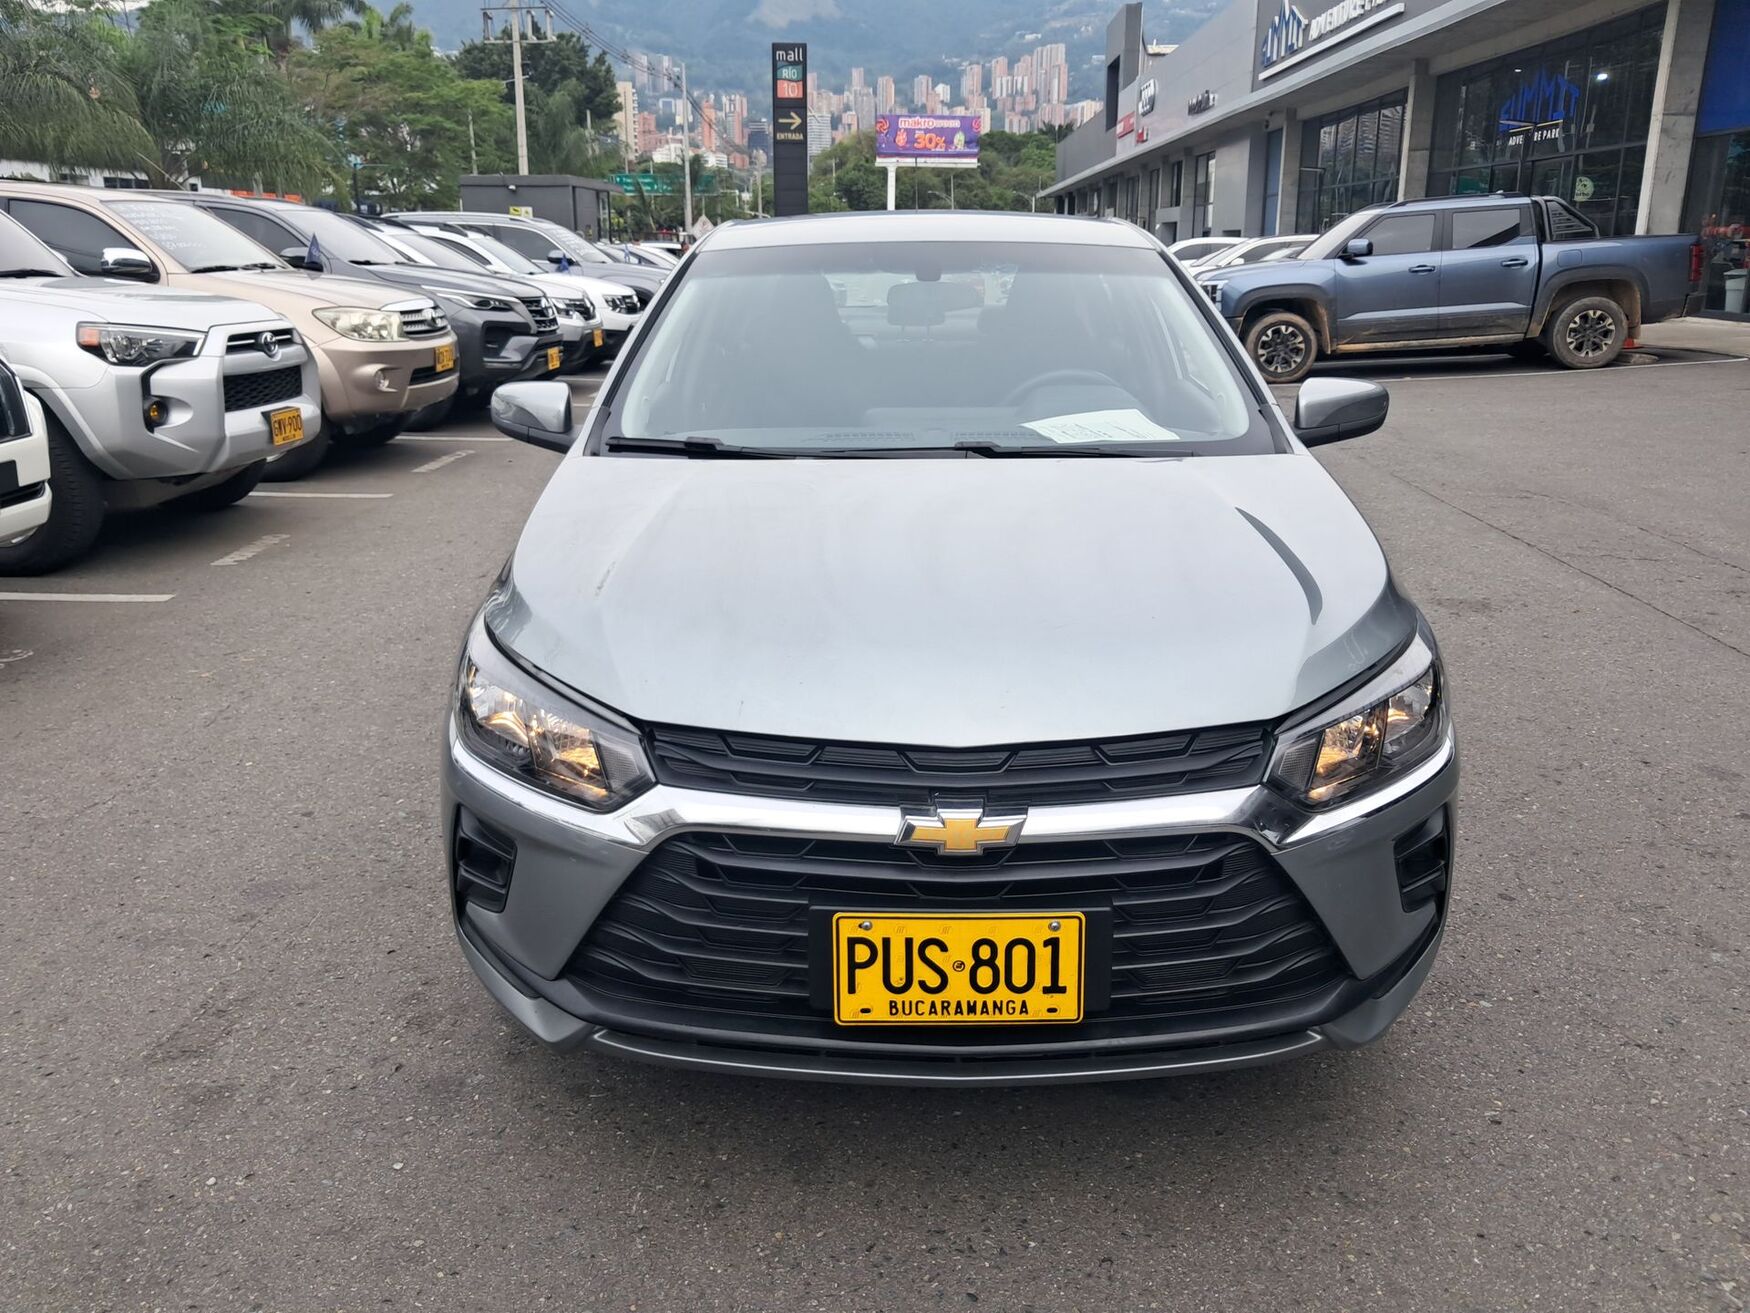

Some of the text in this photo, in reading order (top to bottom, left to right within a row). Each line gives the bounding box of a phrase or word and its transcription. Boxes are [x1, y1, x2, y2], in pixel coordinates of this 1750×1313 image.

[776, 48, 804, 61] mall
[899, 116, 935, 129] makro
[776, 132, 804, 140] ENTRADA
[914, 133, 945, 150] 30%
[889, 999, 1029, 1016] BUCARAMANGA
